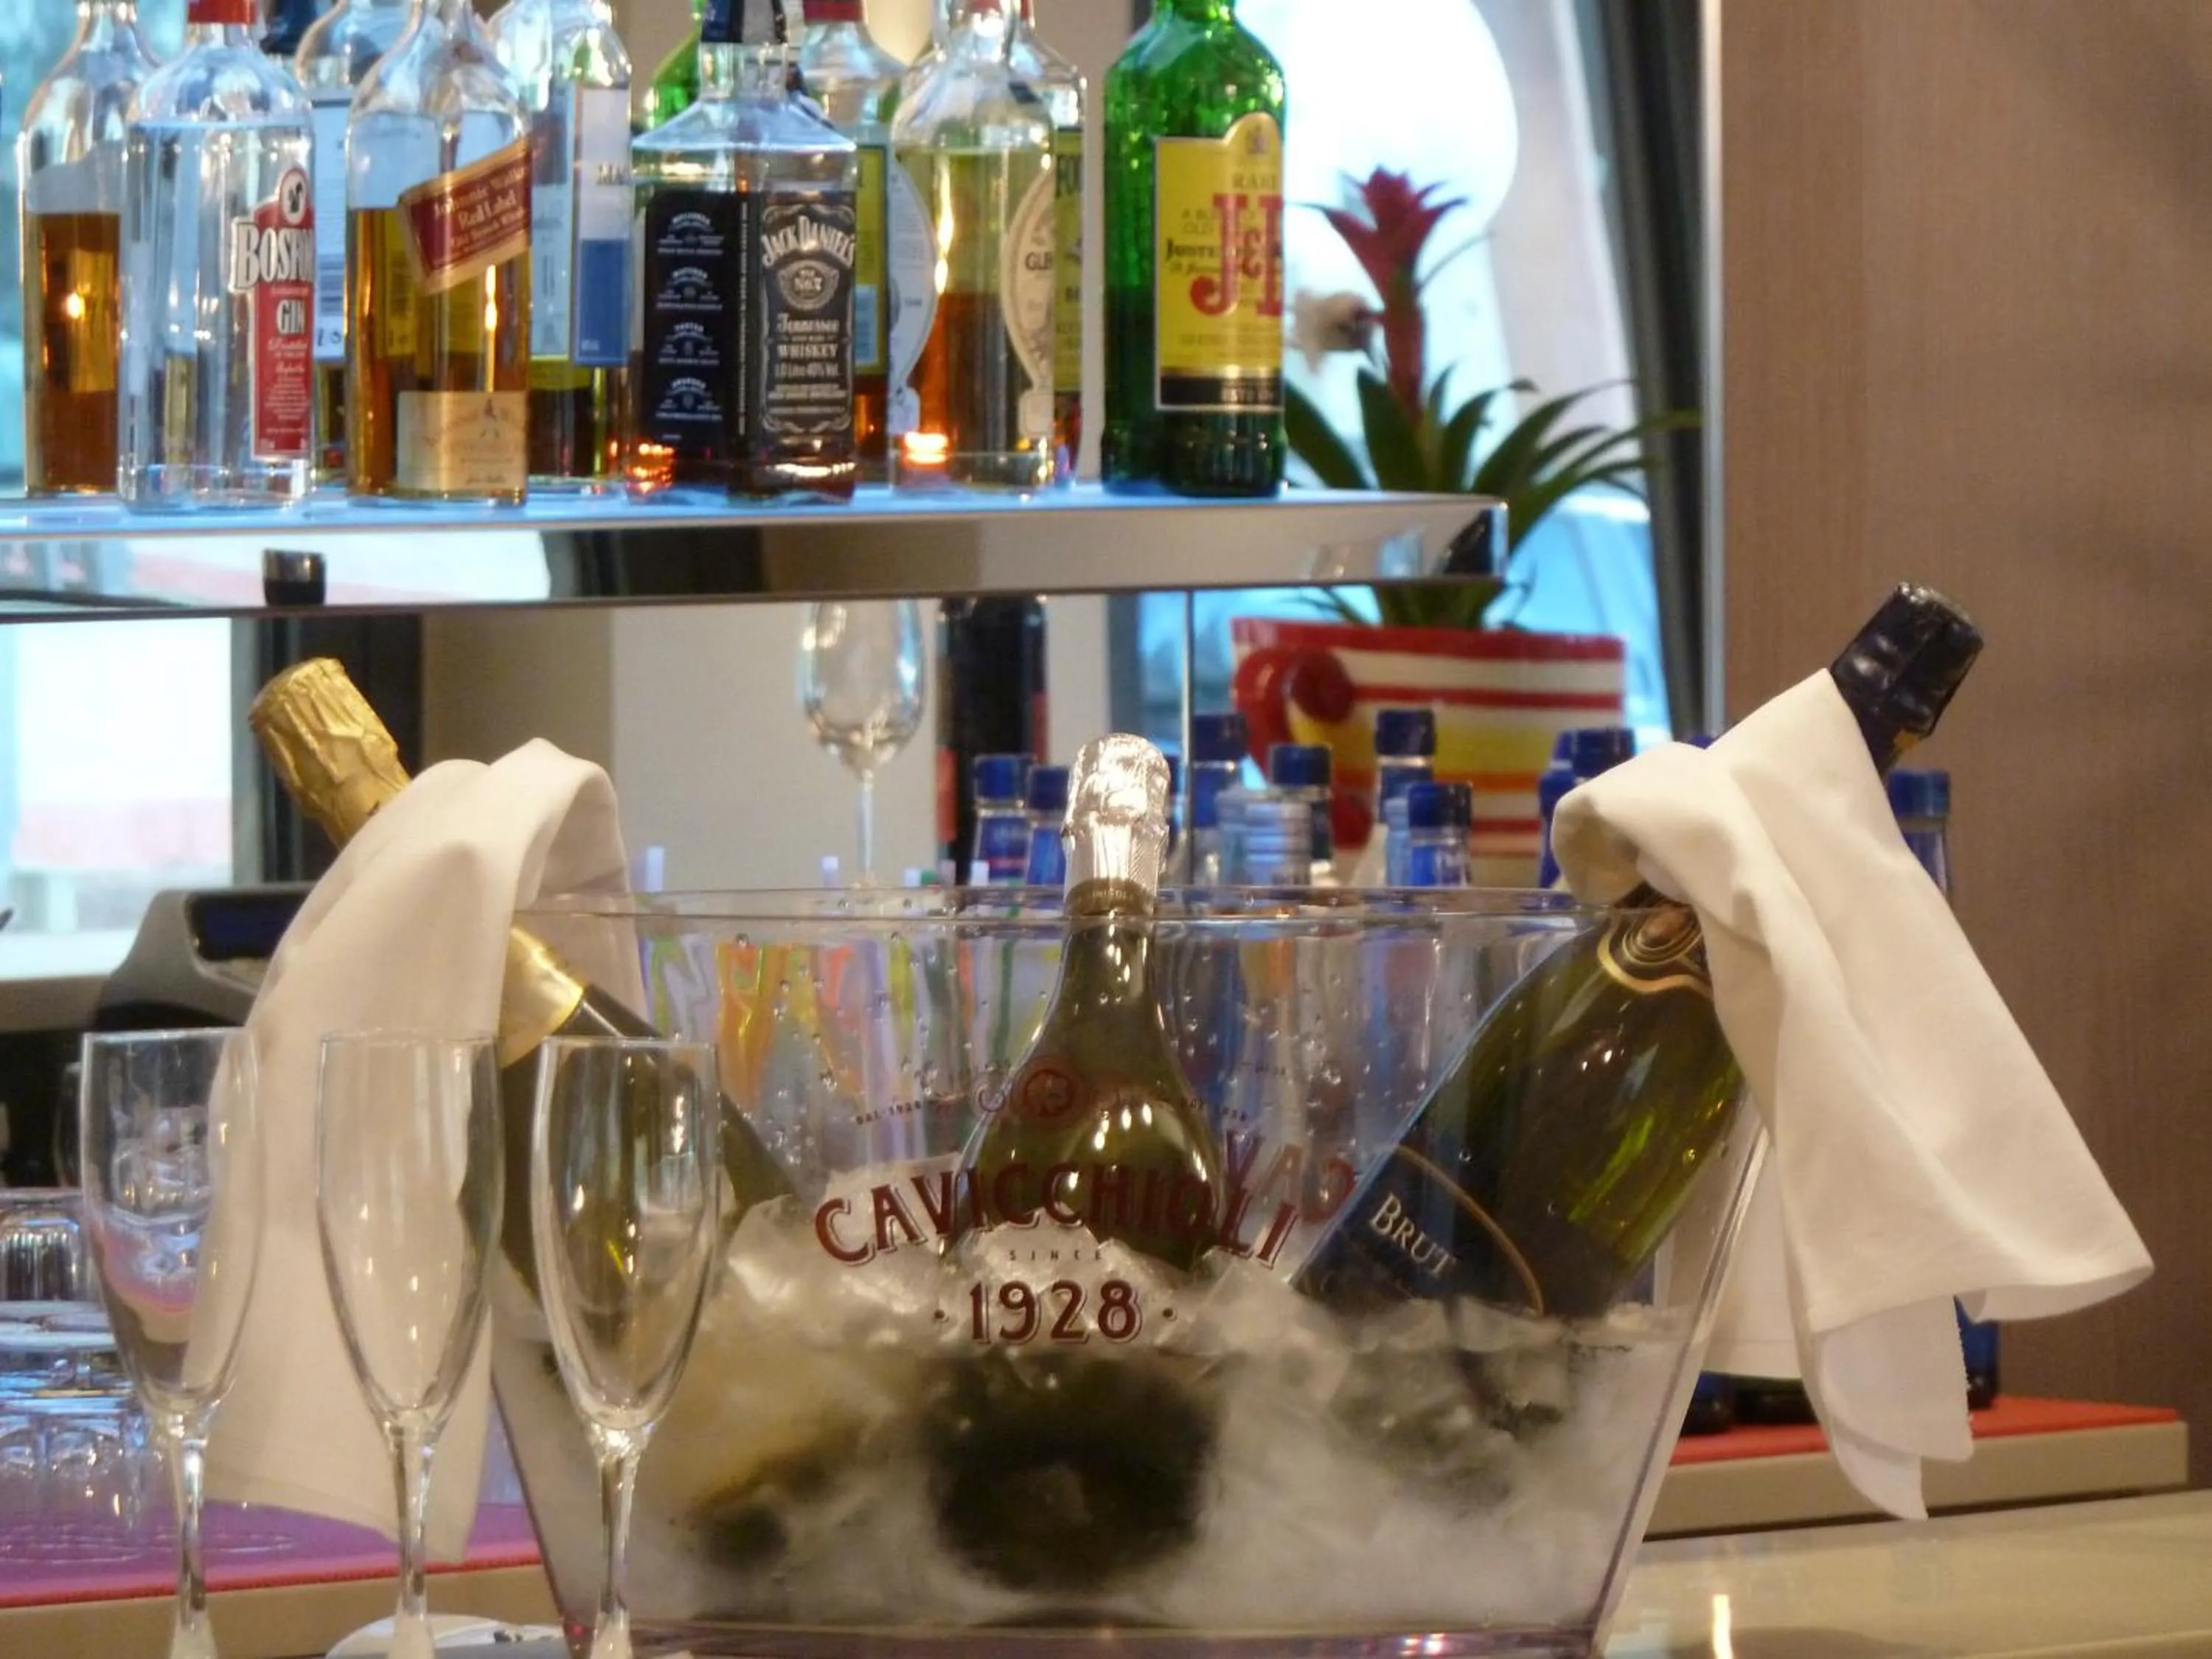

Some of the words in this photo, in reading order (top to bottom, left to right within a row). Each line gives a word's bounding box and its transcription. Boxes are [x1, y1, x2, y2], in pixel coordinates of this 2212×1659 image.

[760, 226, 797, 268] JACK
[776, 344, 838, 358] WHISKEY
[815, 1161, 1298, 1268] CAVICCHIOLI
[1370, 1192, 1457, 1279] BRUT
[1009, 1250, 1102, 1262] SINCE
[969, 1279, 1142, 1346] 1928
